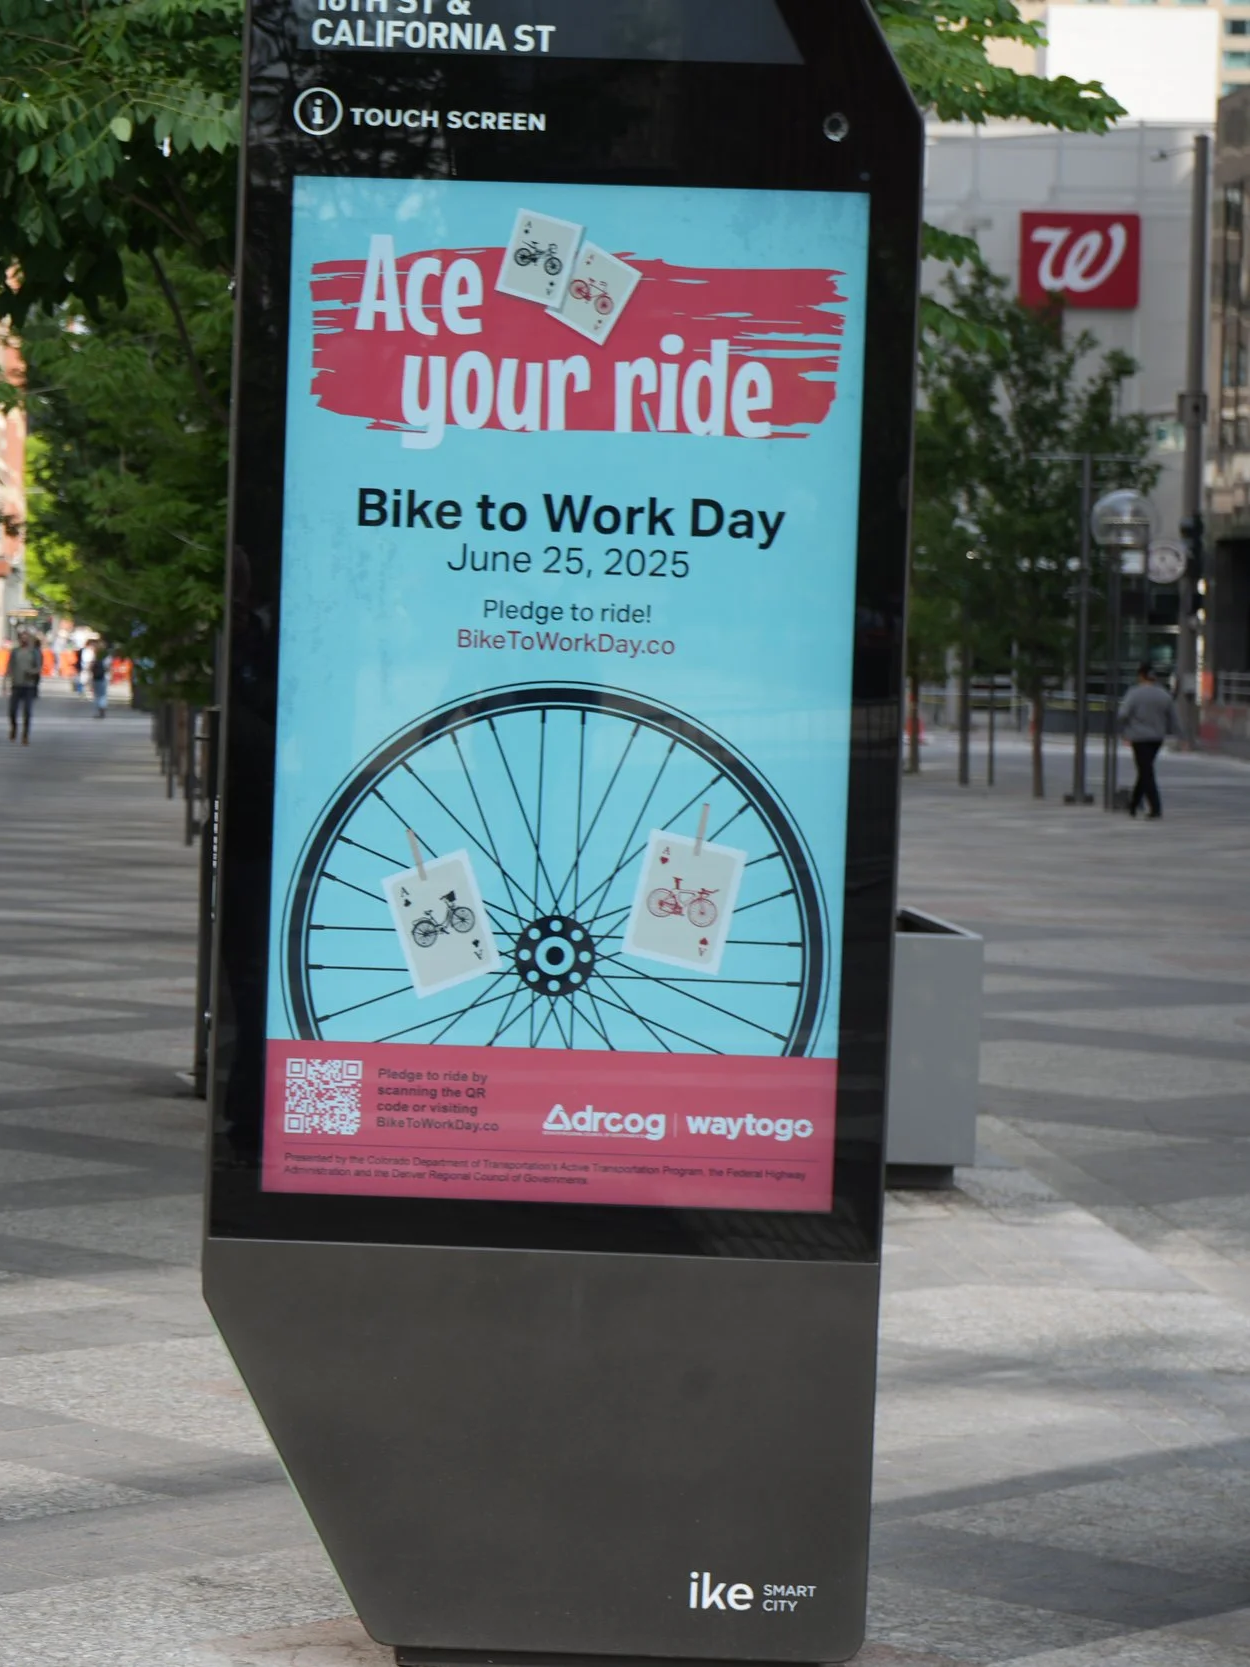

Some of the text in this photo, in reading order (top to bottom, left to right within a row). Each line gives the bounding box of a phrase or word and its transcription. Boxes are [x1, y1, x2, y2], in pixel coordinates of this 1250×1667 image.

[312, 18, 556, 52] CALIFORNIA ST
[350, 107, 546, 131] TOUCH SCREEN
[356, 234, 485, 336] Ace
[400, 334, 773, 450] your ride
[357, 487, 786, 550] Bike to Work Day
[447, 543, 690, 579] June 25, 2025
[483, 599, 651, 626] Pledge to ride!
[457, 629, 675, 659] BikeToWorkDay.co
[377, 1068, 488, 1085] Pledge to ride by
[377, 1085, 486, 1099] scanning the QR
[376, 1101, 478, 1116] code or visiting
[376, 1116, 499, 1133] BikeToWorkDay.co
[685, 1113, 814, 1141] waytogo
[283, 1165, 350, 1176] Administration
[354, 1168, 371, 1177] and
[374, 1168, 389, 1178] the
[392, 1169, 426, 1179] Denver
[429, 1170, 470, 1181] Regional
[473, 1171, 509, 1182] Council
[512, 1173, 521, 1182] of
[284, 1153, 333, 1163] Presented
[335, 1154, 347, 1165] by
[349, 1155, 365, 1164] the
[367, 1155, 411, 1166] Colorado
[414, 1157, 468, 1168] Department
[471, 1158, 480, 1168] of
[560, 1162, 590, 1172] Active
[592, 1163, 659, 1174] Transportation
[708, 1167, 724, 1176] the
[727, 1168, 762, 1178] Federal
[765, 1169, 806, 1181] Highway
[689, 1571, 754, 1611] ike
[763, 1584, 816, 1597] SMART
[762, 1599, 798, 1612] CITY
